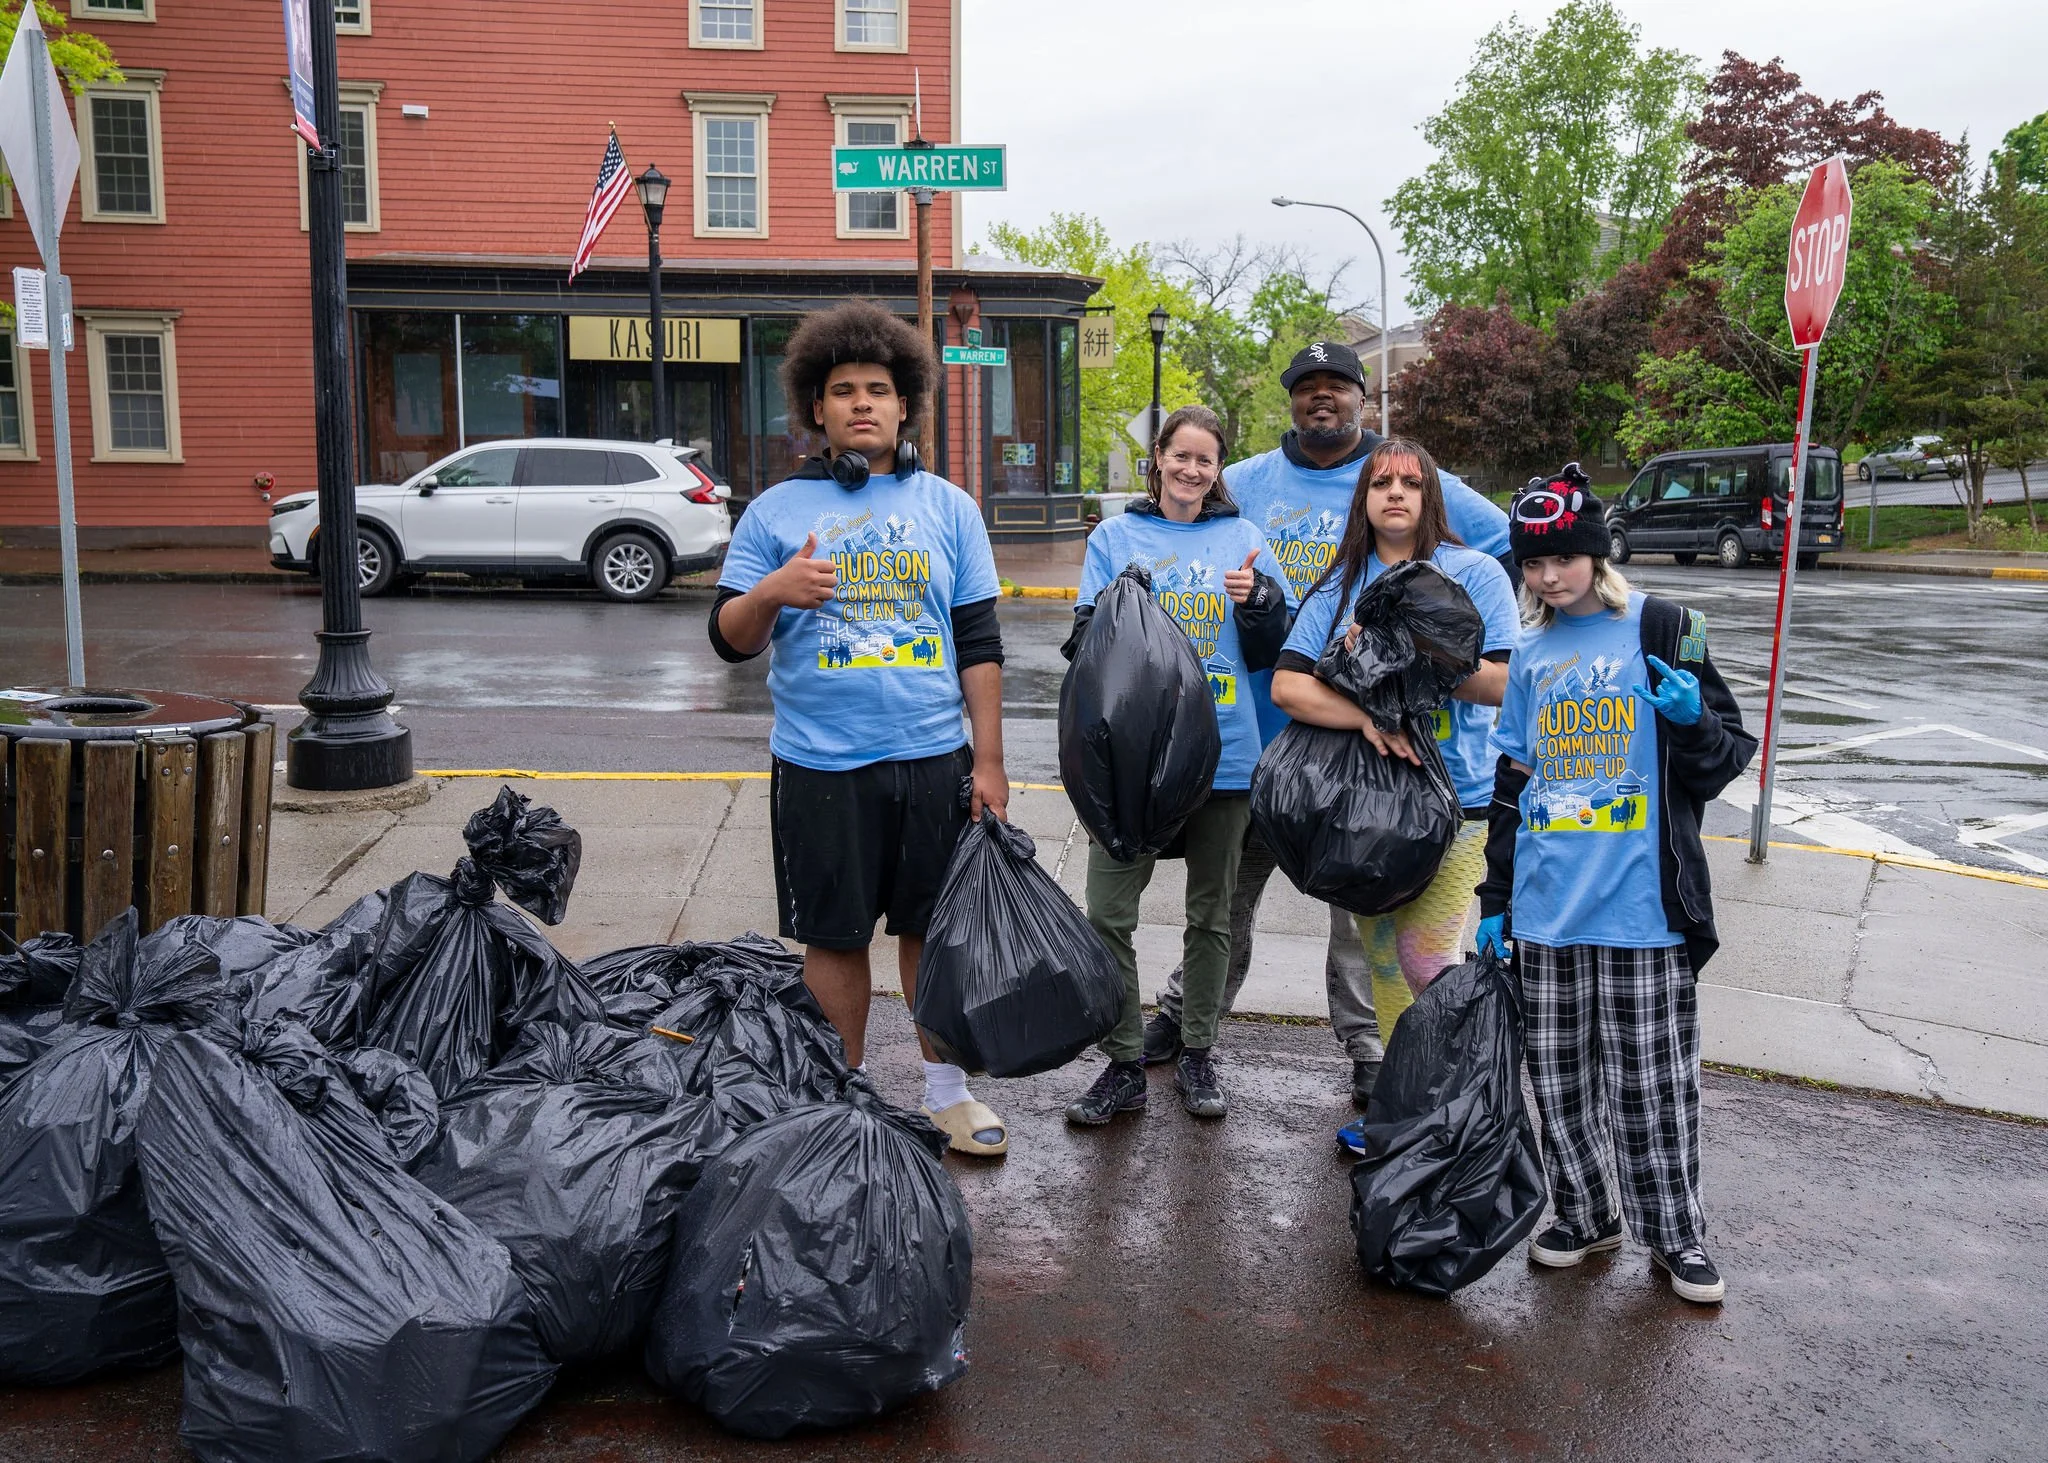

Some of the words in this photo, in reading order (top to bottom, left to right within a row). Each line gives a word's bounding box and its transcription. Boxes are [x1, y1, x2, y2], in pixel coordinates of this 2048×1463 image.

[877, 155, 978, 181] WARREN
[982, 161, 997, 175] ST
[1790, 213, 1845, 292] STOP
[959, 350, 997, 362] WARREN
[1266, 538, 1338, 569] UDSON
[829, 550, 931, 584] HUDSON
[836, 582, 927, 603] COMMUNITY
[842, 602, 923, 622] CLEAN-UP
[1151, 591, 1226, 624] DSON
[1536, 696, 1636, 738] HUDSON
[1535, 733, 1632, 759] COMMUNITY
[1543, 757, 1627, 782] CLEAN-UP
